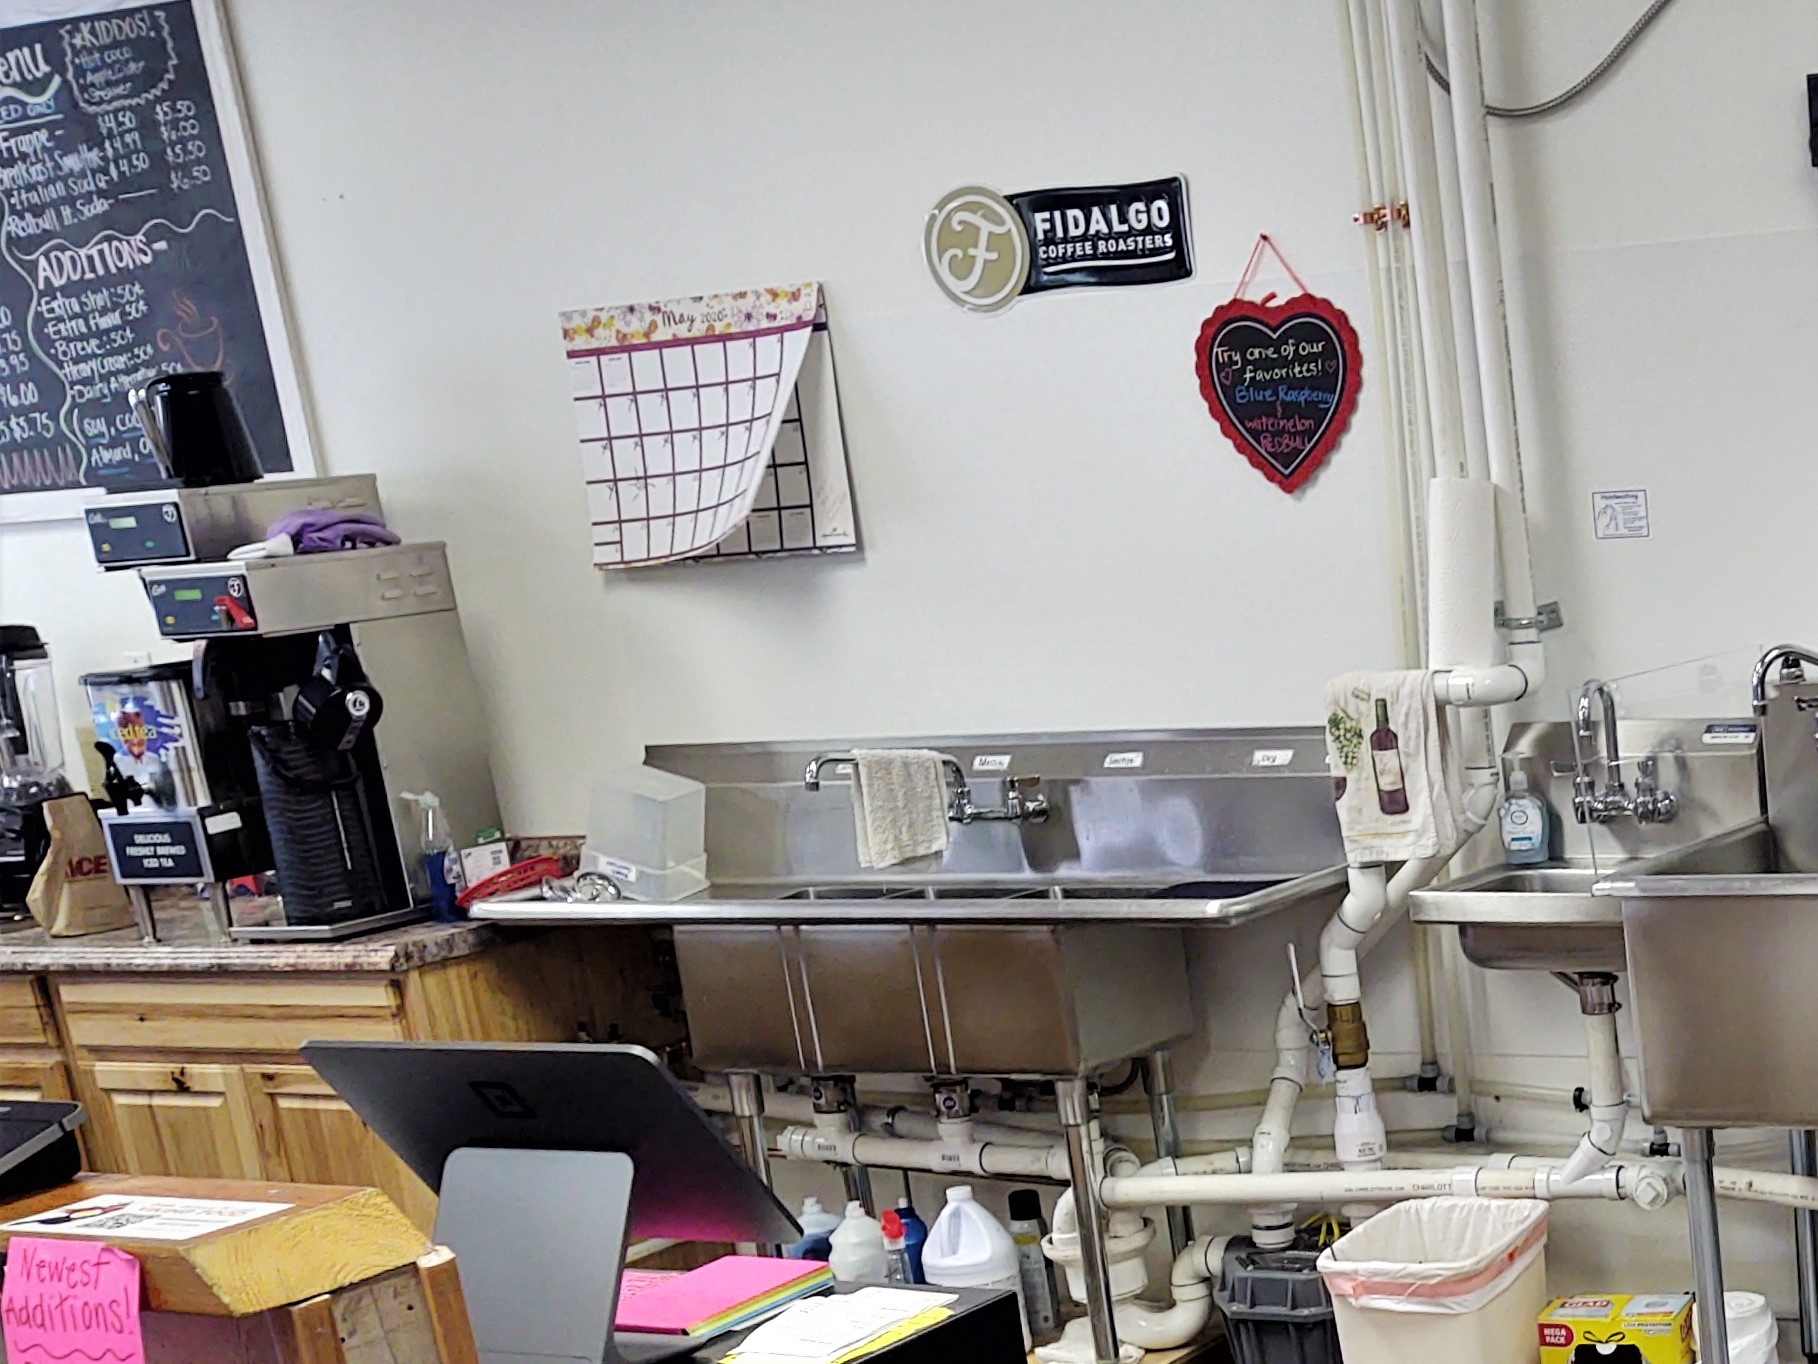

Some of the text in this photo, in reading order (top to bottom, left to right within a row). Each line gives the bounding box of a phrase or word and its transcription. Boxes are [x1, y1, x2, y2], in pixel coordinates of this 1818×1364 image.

[80, 10, 156, 47] KIDDOS!
[1033, 200, 1172, 240] FIDALGO
[1039, 232, 1173, 260] COFFEE ROASTERS
[41, 291, 82, 319] Extra
[47, 316, 87, 340] Extra
[661, 310, 724, 333] May 2020
[1216, 338, 1327, 369] Try one of our
[1243, 358, 1323, 387] favorites!
[1235, 385, 1277, 404] Blue
[1244, 414, 1315, 433] watermelon
[133, 832, 172, 844] DELICIOUS
[125, 844, 187, 857] FRESHLY BREWED
[159, 857, 175, 868] TEA
[19, 1248, 111, 1290] Newest
[4, 1286, 134, 1335] Additions!
[1543, 1327, 1567, 1336] MEGA
[1545, 1335, 1566, 1344] PACK
